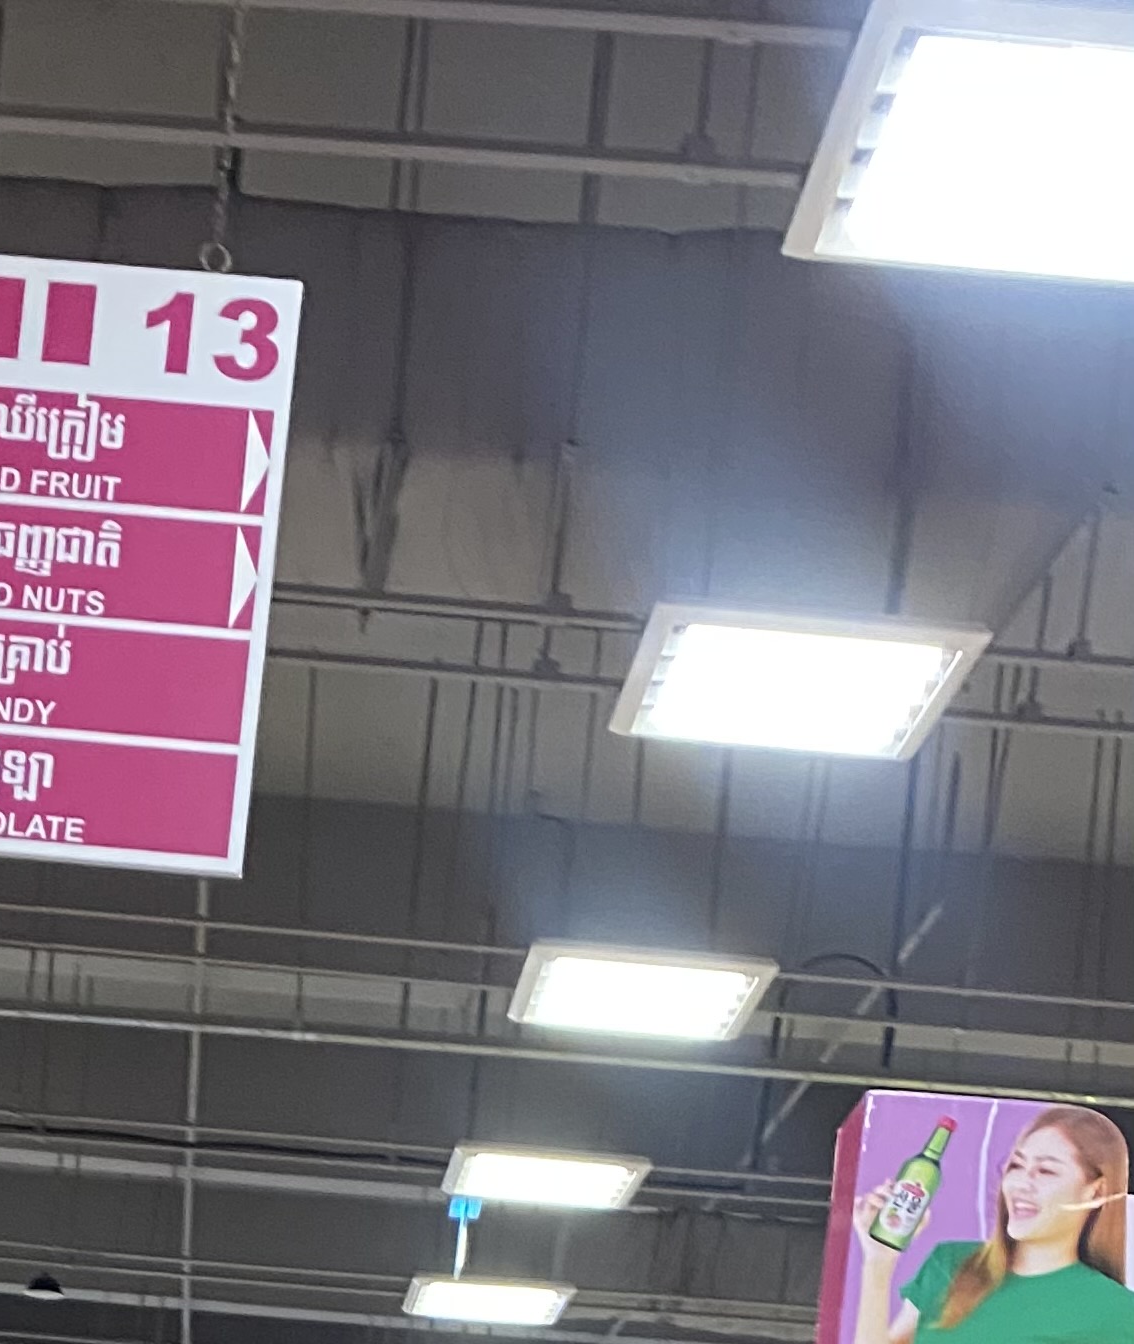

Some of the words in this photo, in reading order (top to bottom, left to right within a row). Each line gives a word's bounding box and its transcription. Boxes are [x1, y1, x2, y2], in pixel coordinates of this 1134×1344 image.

[146, 292, 279, 381] 13
[30, 470, 121, 501] FRUIT
[21, 584, 105, 616] NUTS
